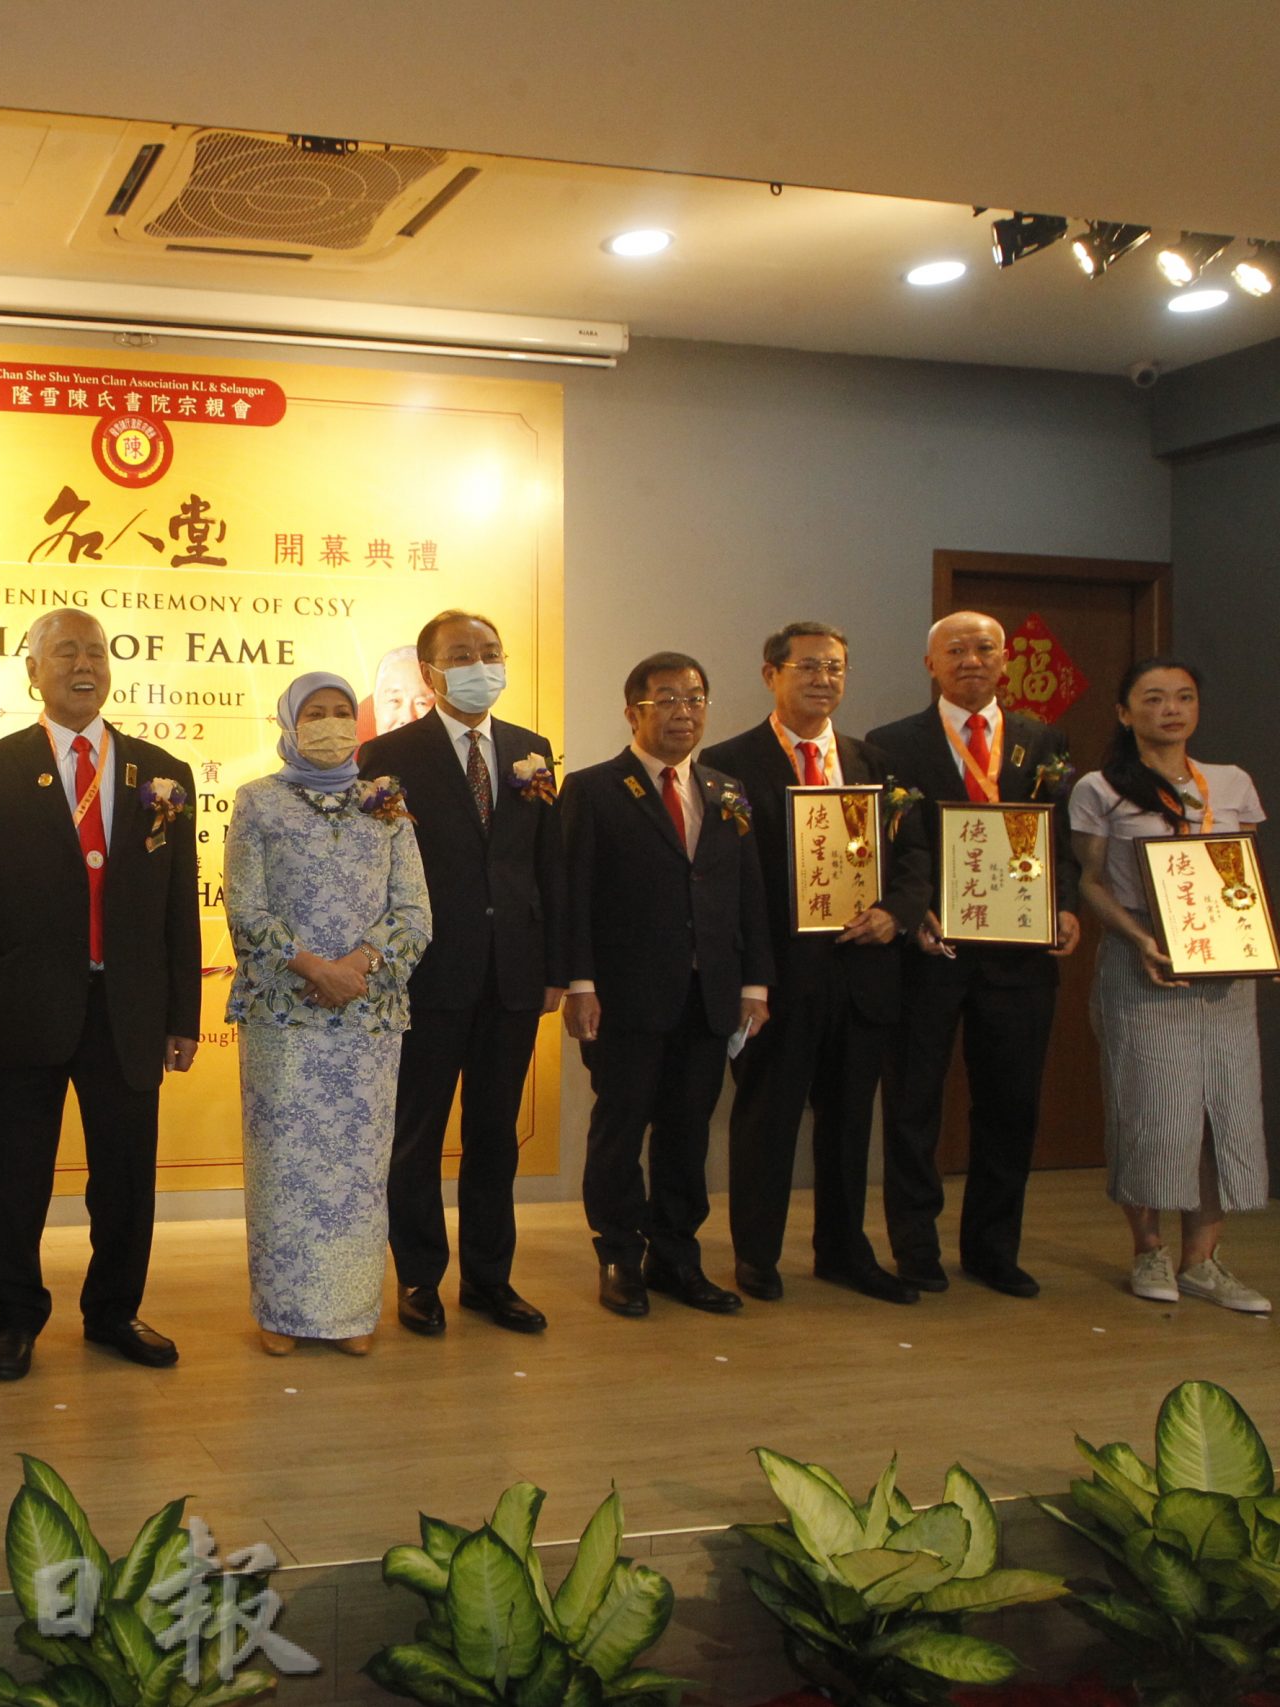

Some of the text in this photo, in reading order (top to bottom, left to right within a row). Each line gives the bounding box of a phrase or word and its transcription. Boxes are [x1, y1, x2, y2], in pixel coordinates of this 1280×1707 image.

[26, 370, 46, 382] She
[48, 371, 70, 383] Shu
[73, 373, 99, 385] Yuen
[101, 374, 127, 386] Clan
[129, 376, 189, 391] Association
[192, 381, 207, 392] KL
[209, 381, 218, 392] &
[219, 382, 265, 398] Selangor
[12, 385, 252, 420] 隆雪陳氏書院宗親會
[123, 435, 144, 460] 陳
[27, 485, 228, 568] 名人堂
[274, 533, 440, 572] 開幕典禮
[101, 589, 243, 614] CEREMONY
[294, 596, 355, 617] CSSY
[185, 632, 295, 665] FAME
[1006, 636, 1058, 702] 福
[113, 683, 246, 707] of Honour
[806, 803, 832, 921] 德星光耀
[959, 817, 989, 931] 德星光耀
[1167, 851, 1216, 965] 德星光耀
